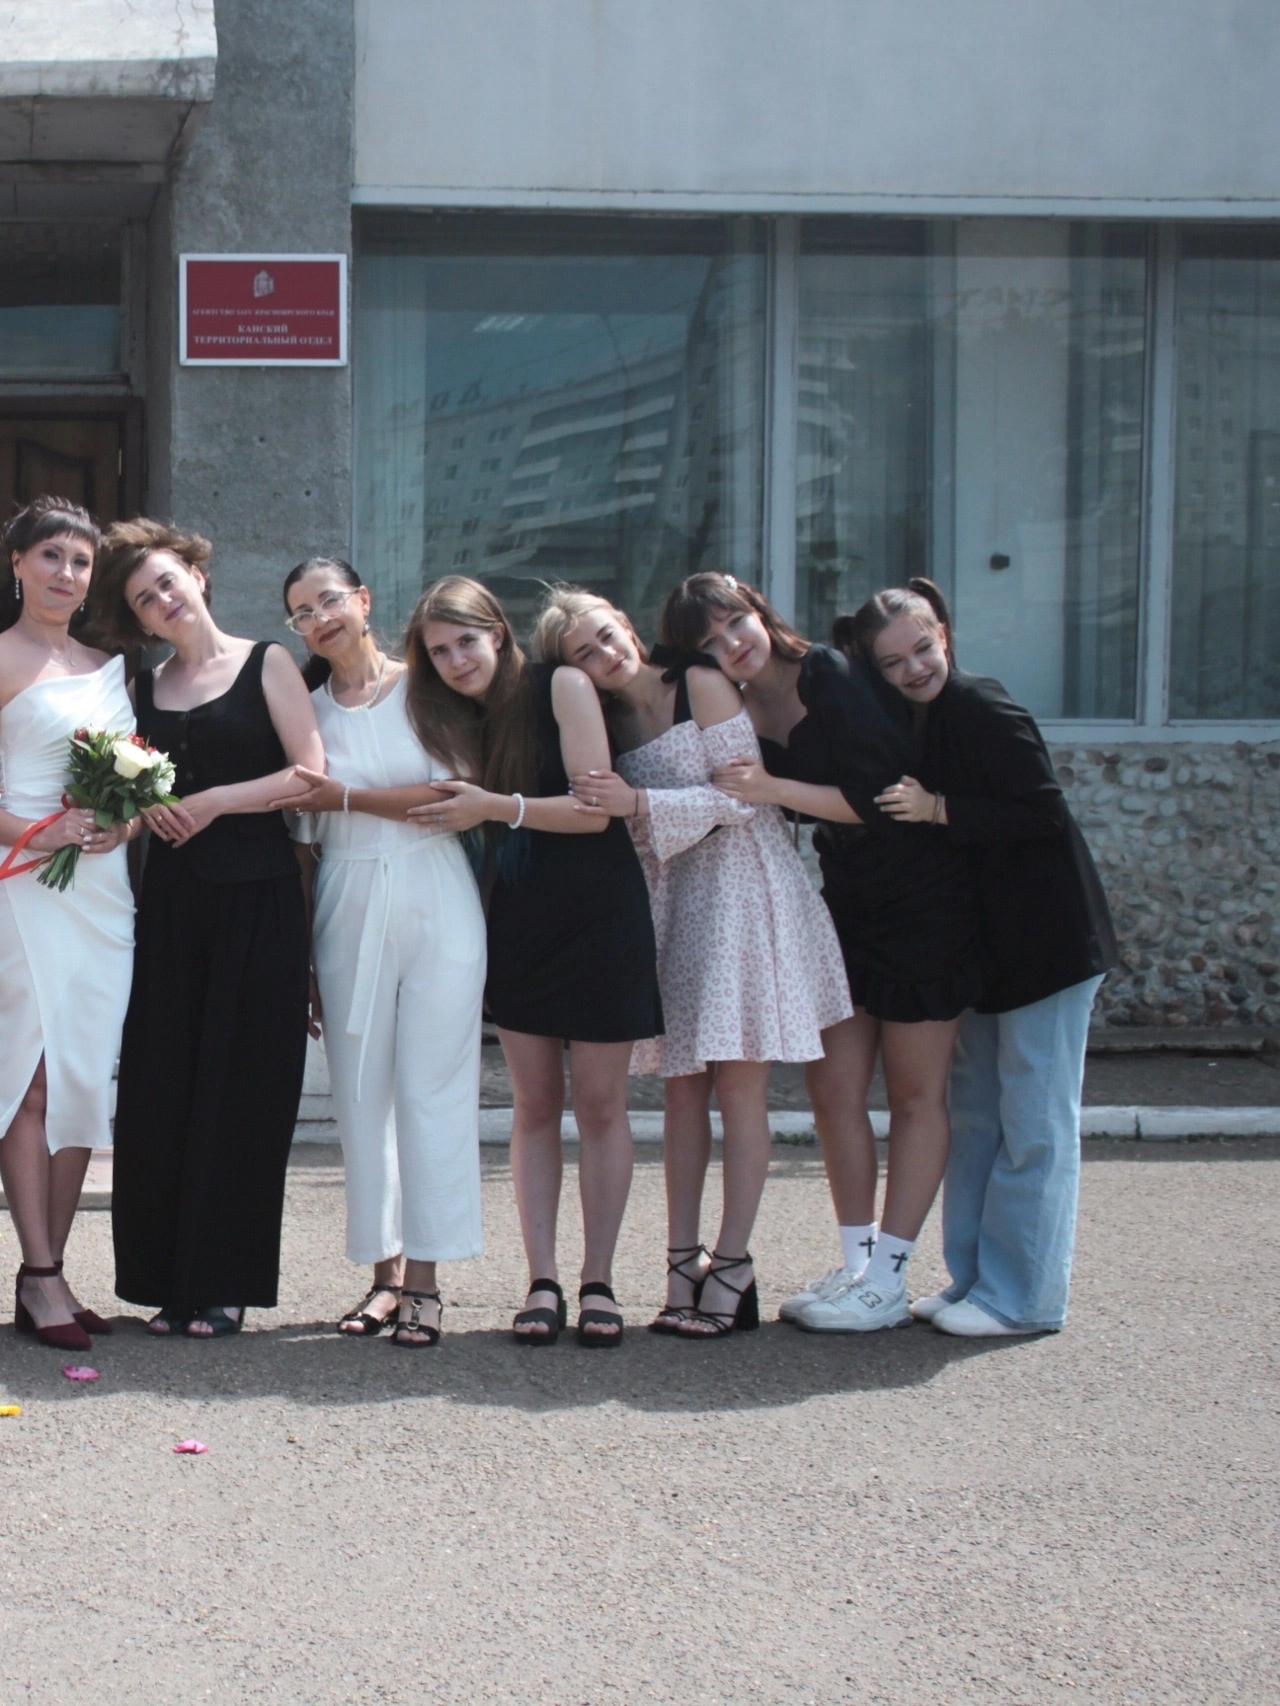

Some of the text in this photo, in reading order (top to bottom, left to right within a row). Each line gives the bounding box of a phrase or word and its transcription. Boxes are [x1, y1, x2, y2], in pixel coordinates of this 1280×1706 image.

[238, 324, 289, 334] КАНСКИЙ
[194, 334, 333, 346] ТЕРРИТОРИАЛЬНЫЙ ОТДЕЛ
